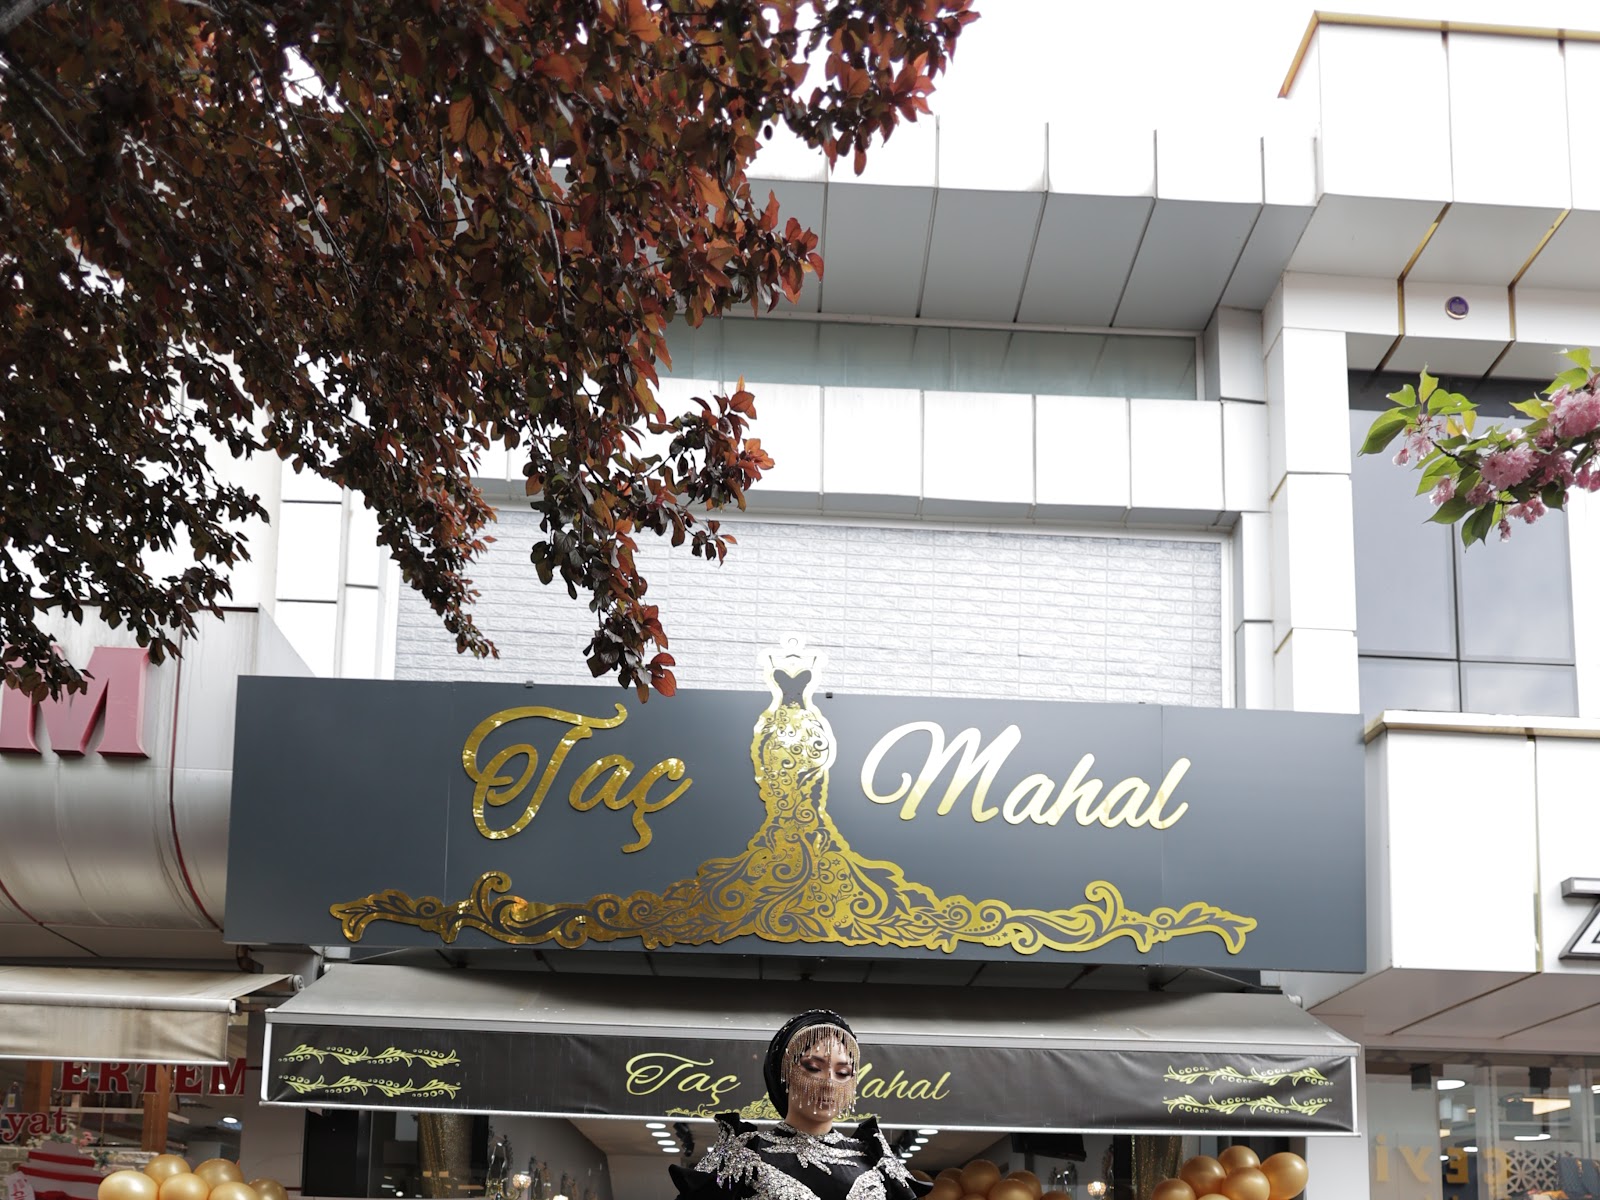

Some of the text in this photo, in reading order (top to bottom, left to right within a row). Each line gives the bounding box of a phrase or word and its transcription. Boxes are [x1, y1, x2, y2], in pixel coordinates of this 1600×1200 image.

[461, 702, 1193, 854] Taç Mahal
[57, 1057, 247, 1096] ERTEM
[625, 1052, 952, 1107] Taç ahal
[0, 1107, 68, 1143] yat
